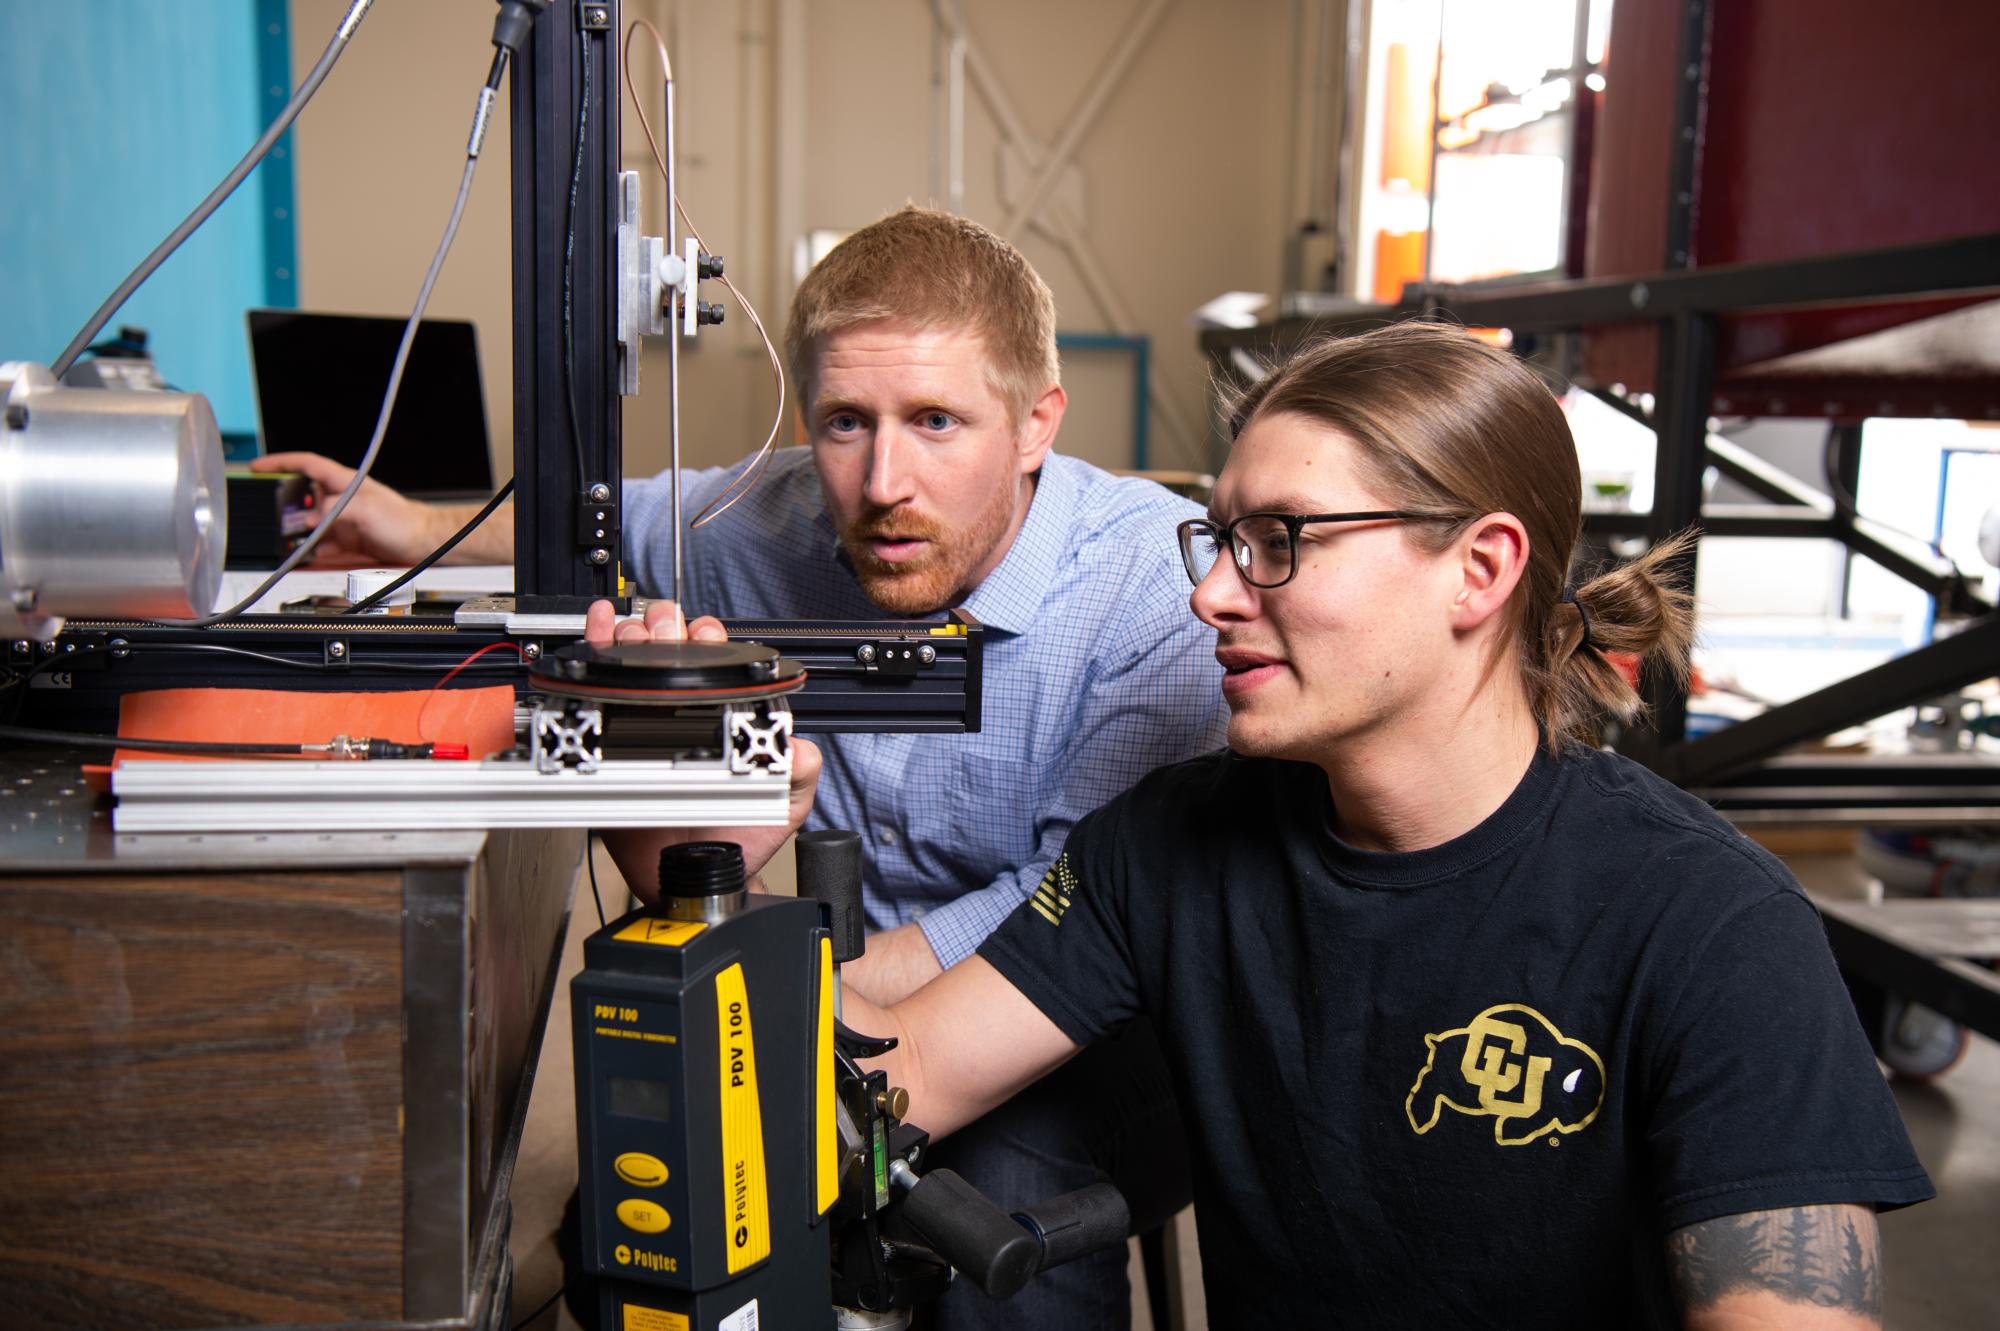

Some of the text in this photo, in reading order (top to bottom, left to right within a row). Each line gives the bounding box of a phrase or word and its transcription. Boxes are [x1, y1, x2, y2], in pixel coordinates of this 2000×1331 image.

[595, 1004, 639, 1023] PDV 100
[729, 1002, 744, 1088] PDV 100
[1460, 1018, 1552, 1118] CU
[734, 1160, 747, 1222] Polytec
[632, 1210, 652, 1223] SET
[634, 1249, 678, 1273] Polytec
